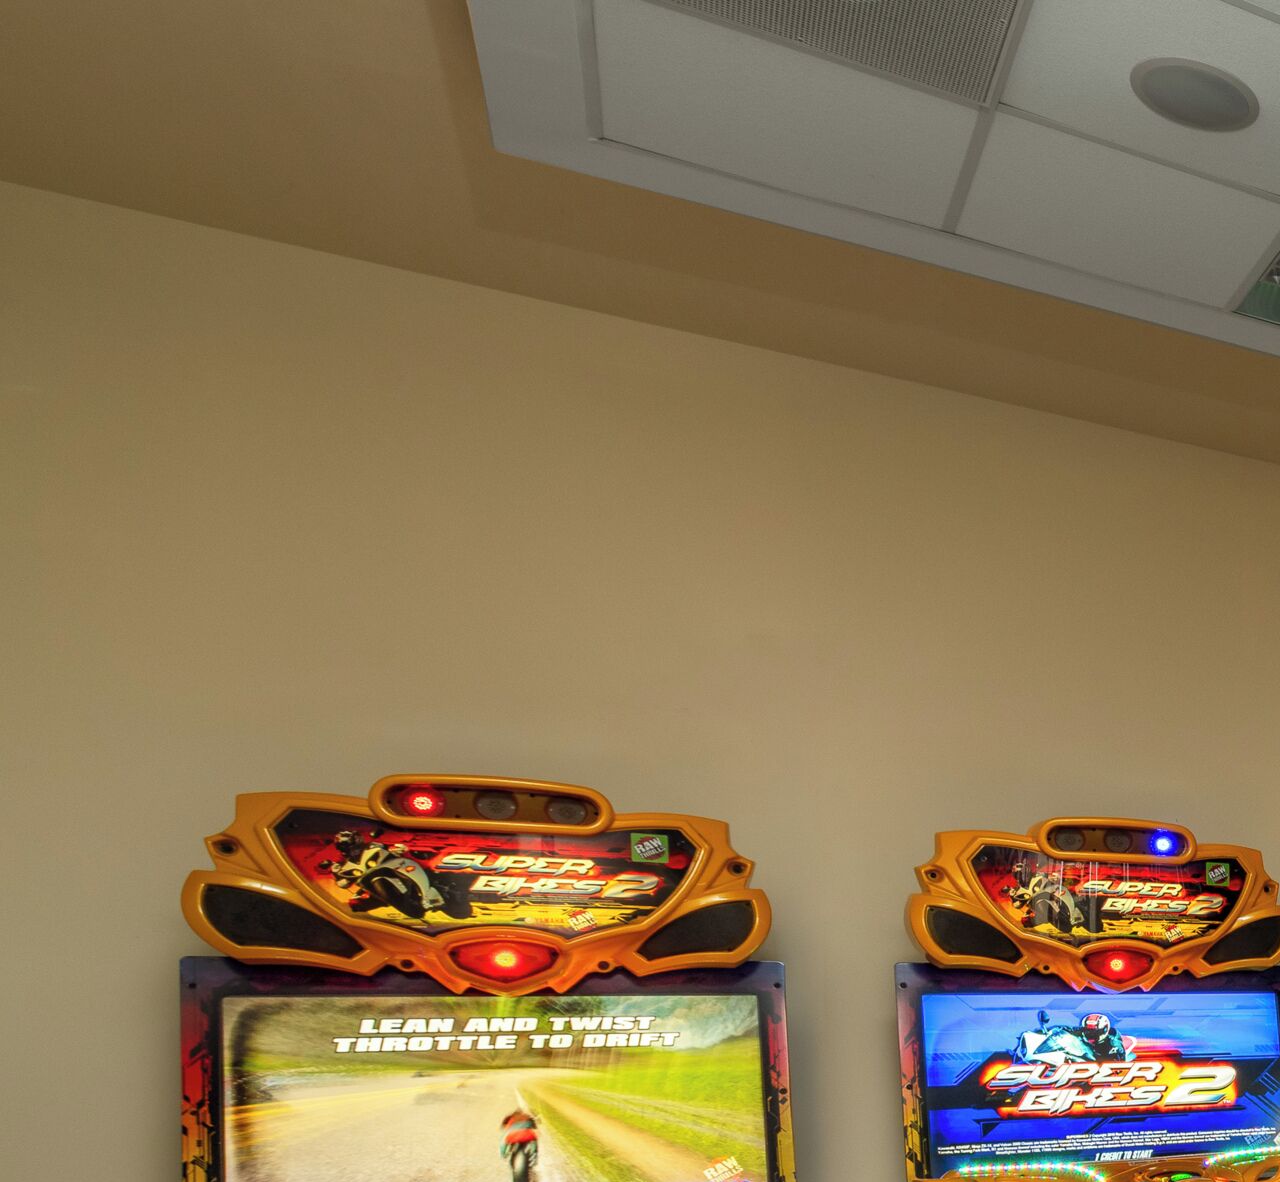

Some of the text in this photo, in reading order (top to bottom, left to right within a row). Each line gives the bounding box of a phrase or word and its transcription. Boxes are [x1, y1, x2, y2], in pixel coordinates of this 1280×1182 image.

[634, 837, 662, 854] RAW
[437, 854, 596, 875] SUPER
[471, 875, 659, 897] BIKES 2
[1080, 880, 1182, 898] SUPER
[1102, 895, 1223, 915] BIKES 2
[359, 1015, 655, 1033] LEAN AND TWIST
[332, 1031, 680, 1053] THROTTLE TO DRIFT
[987, 1062, 1164, 1089] SUPER
[1018, 1066, 1236, 1114] BIKES 2
[1100, 1149, 1153, 1161] CREDIT TO START
[703, 1157, 740, 1179] RAW
